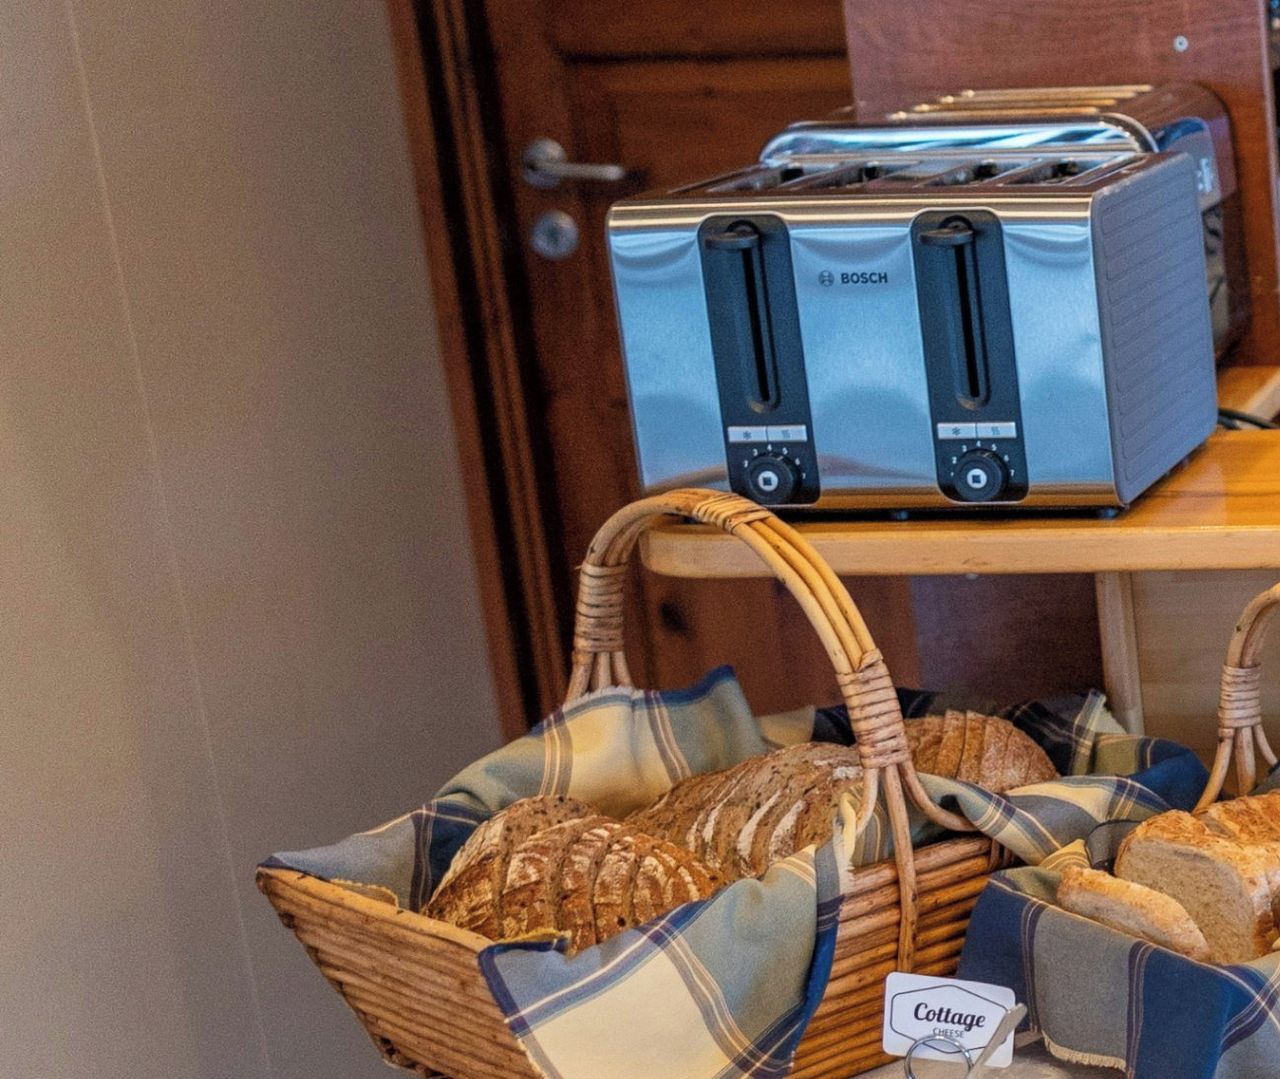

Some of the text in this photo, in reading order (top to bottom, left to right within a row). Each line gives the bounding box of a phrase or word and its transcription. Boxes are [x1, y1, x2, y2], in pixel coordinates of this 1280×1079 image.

[840, 272, 888, 284] BOSCH
[914, 1002, 986, 1032] Cottage
[932, 1027, 965, 1038] CHEESE
